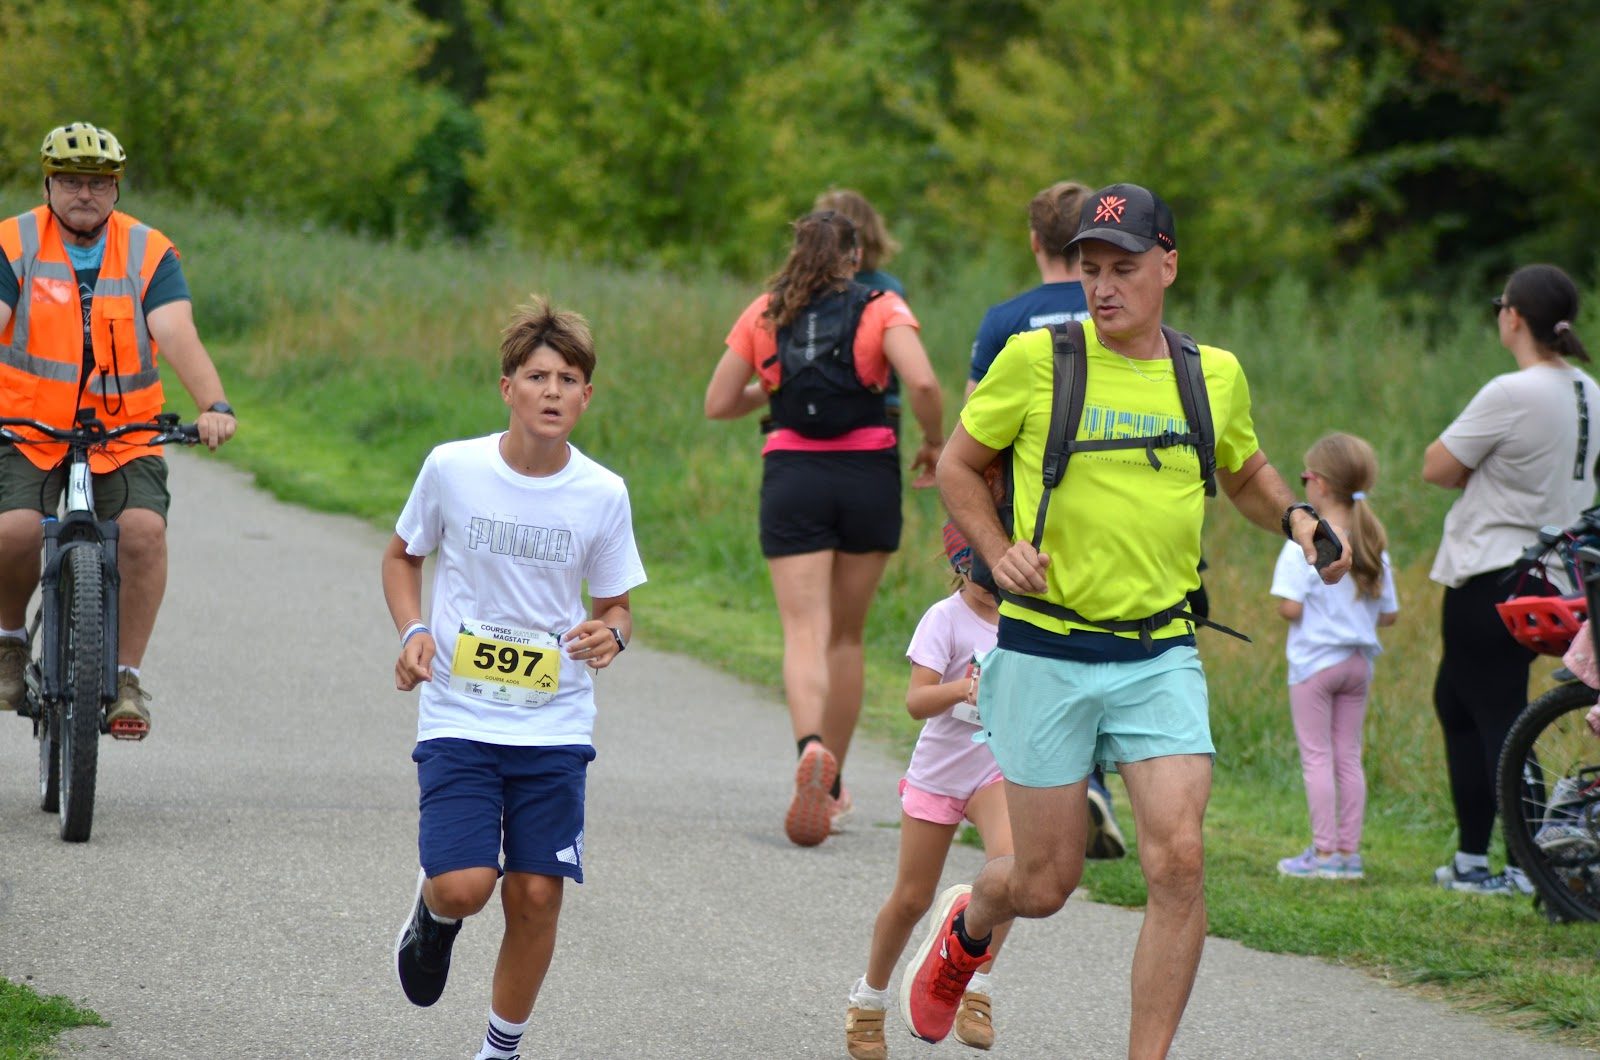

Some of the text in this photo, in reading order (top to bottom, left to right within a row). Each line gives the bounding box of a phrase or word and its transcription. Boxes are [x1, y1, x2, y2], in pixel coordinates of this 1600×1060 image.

[469, 516, 571, 562] PUMA
[480, 624, 512, 635] COURSES
[493, 633, 530, 645] MAGSTATT
[473, 642, 544, 677] 597
